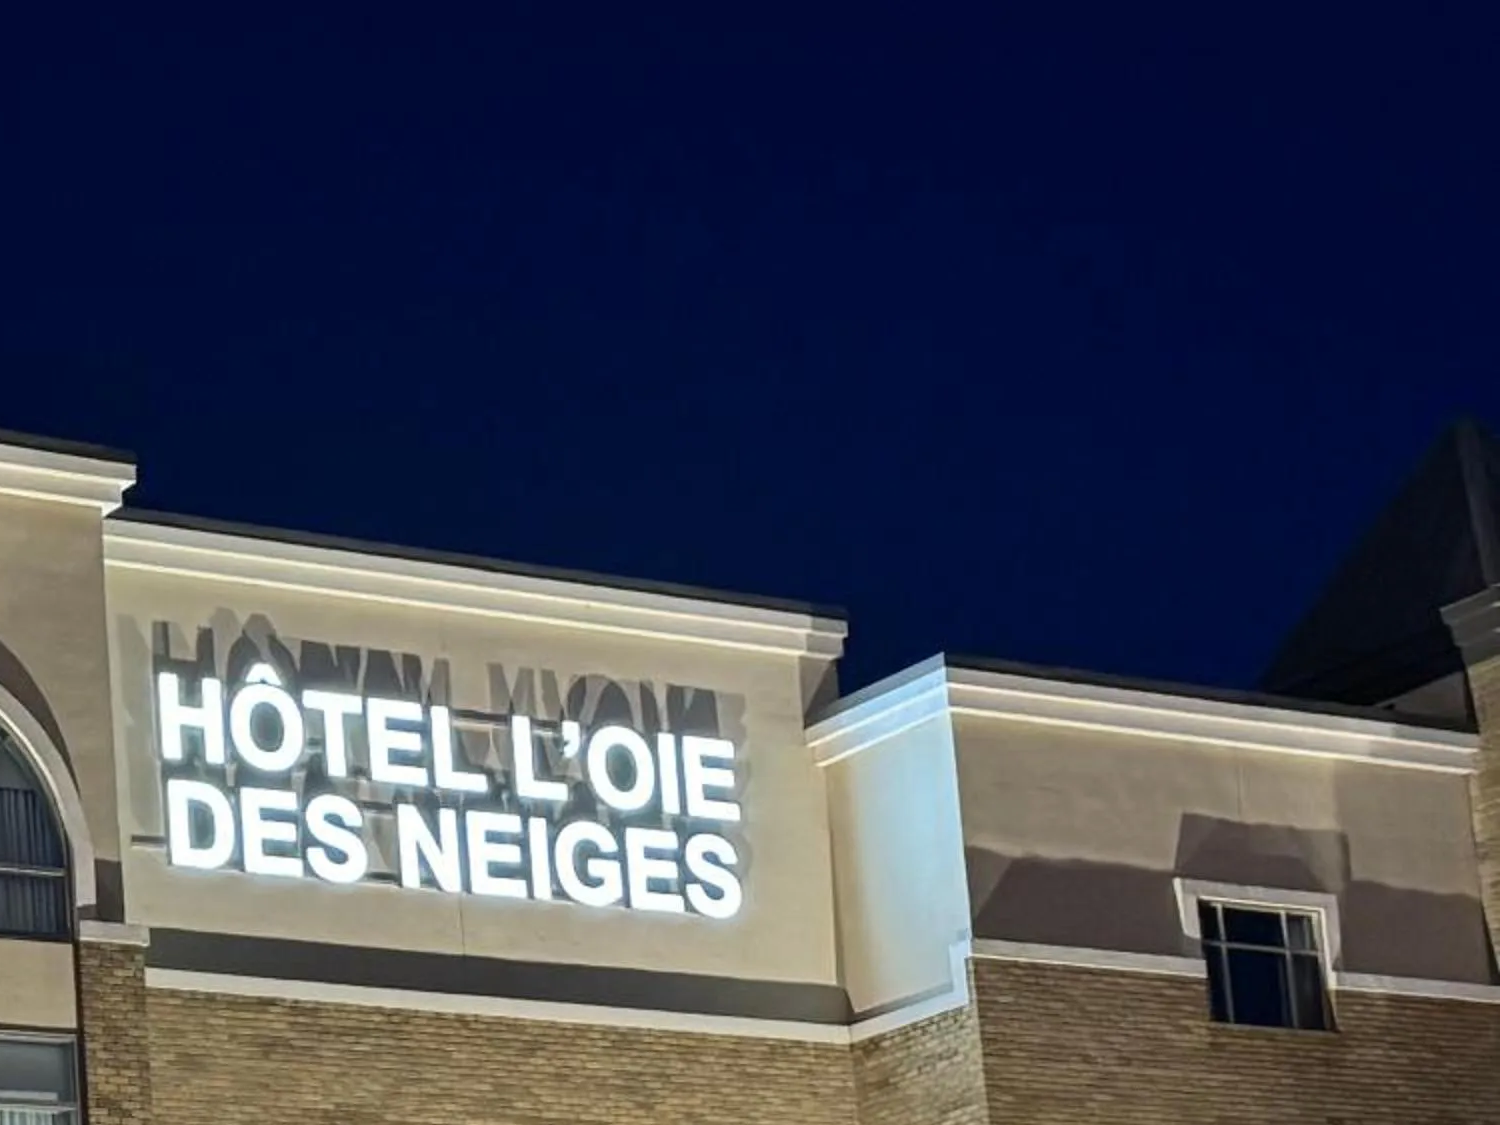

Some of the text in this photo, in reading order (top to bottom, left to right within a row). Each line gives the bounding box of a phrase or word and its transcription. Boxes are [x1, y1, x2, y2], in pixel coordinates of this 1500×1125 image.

[158, 663, 741, 821] HÔTEL L'OIE
[167, 779, 742, 919] DES NEIGES
